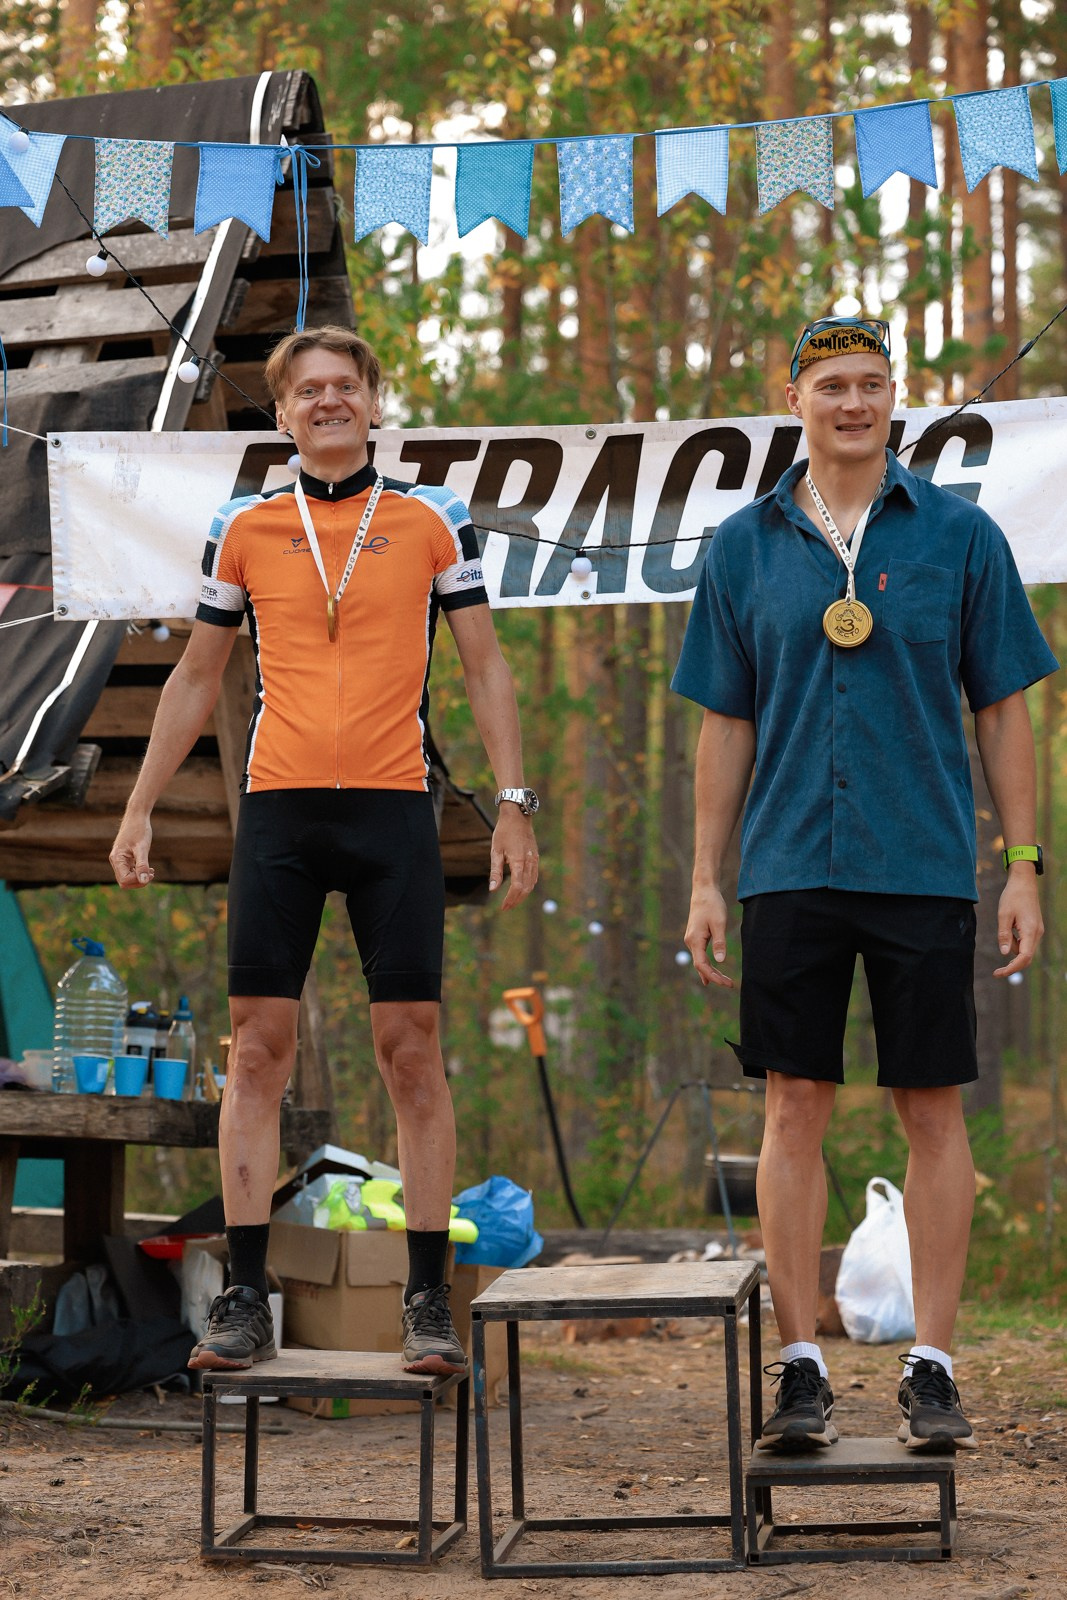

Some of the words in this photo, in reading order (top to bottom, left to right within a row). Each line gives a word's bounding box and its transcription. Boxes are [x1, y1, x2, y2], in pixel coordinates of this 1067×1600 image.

[809, 334, 849, 350] SANTIC
[834, 625, 860, 638] МЕСТО
[840, 618, 855, 632] 3
